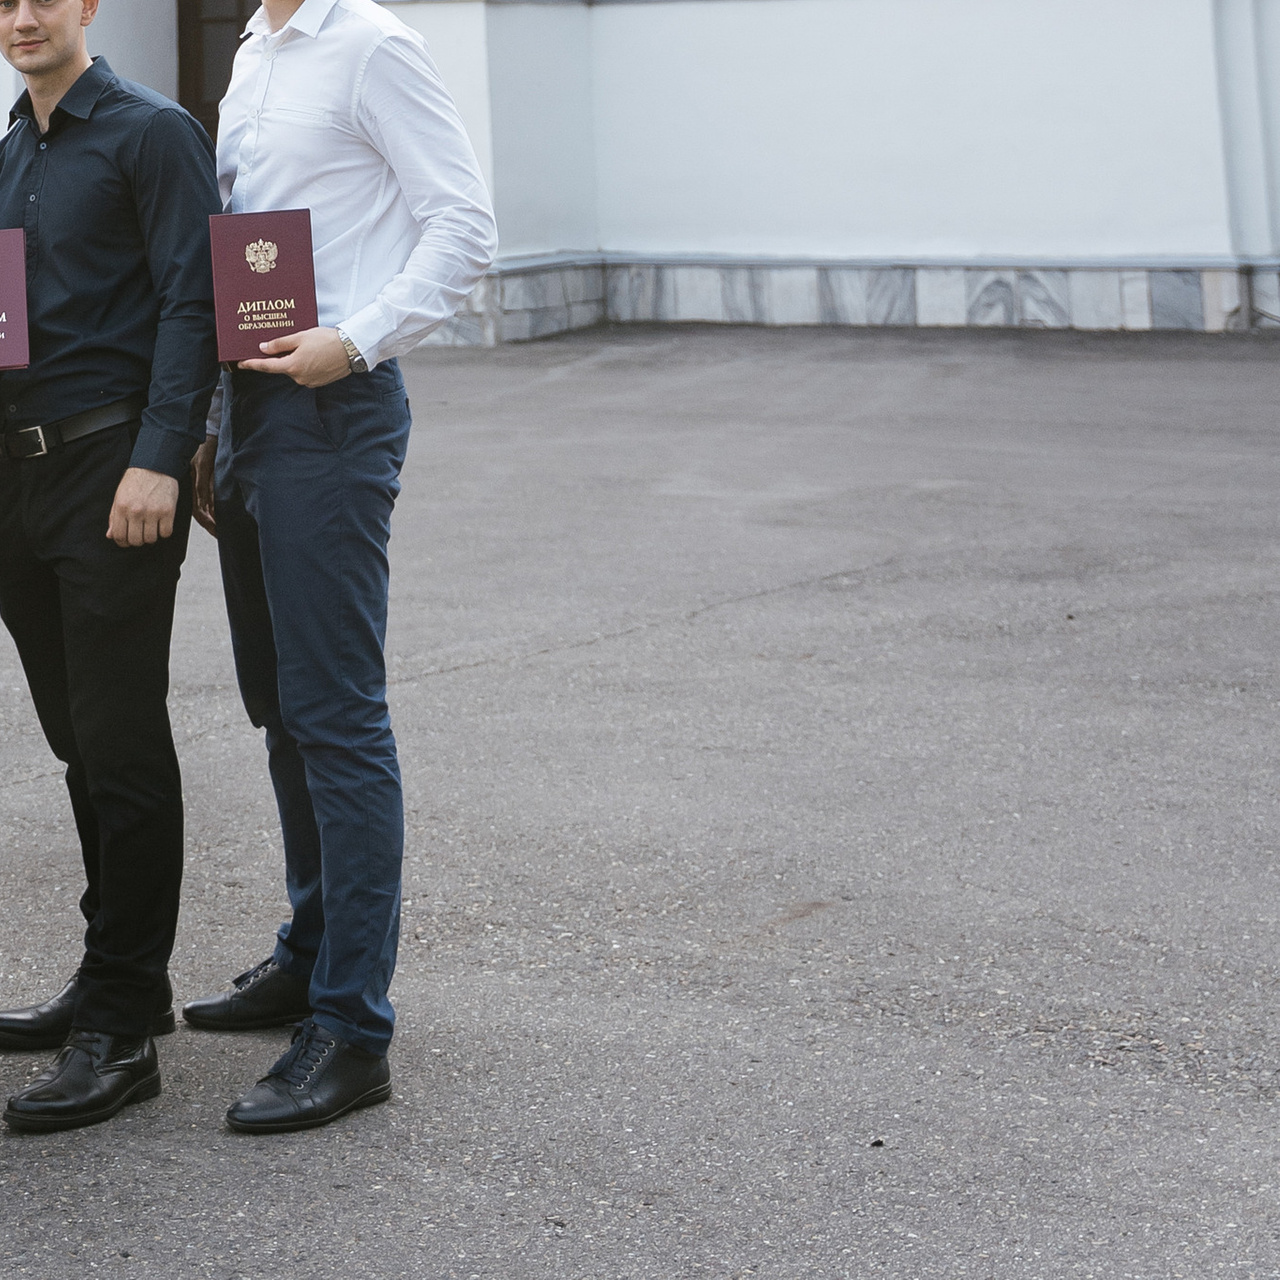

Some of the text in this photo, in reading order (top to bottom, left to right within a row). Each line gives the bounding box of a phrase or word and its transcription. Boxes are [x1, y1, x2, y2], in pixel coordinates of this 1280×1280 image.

[237, 298, 295, 314] ДИПЛОМ
[252, 312, 287, 321] ВЫСШЕМ
[238, 320, 294, 330] ОБРАЗОВАНИИ
